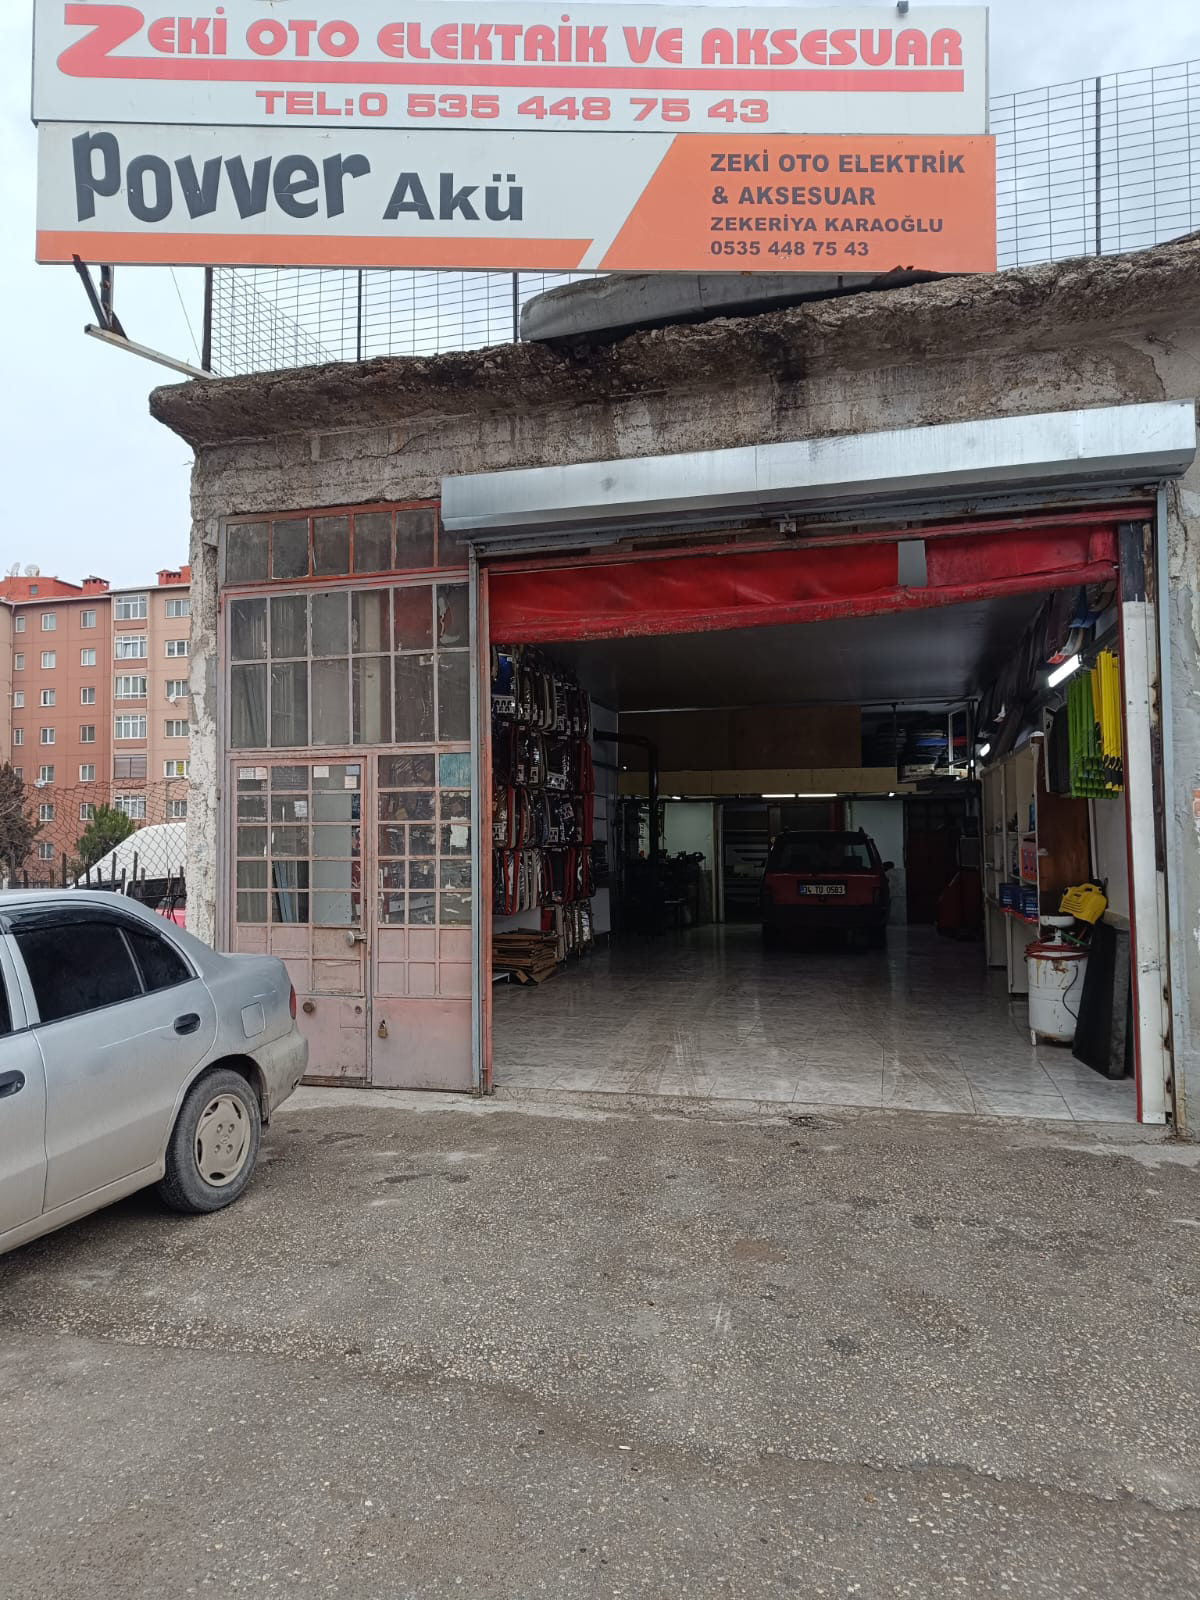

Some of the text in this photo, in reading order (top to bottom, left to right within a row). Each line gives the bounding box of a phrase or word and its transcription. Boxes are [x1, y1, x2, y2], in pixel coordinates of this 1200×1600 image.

[57, 3, 963, 78] ZEKİ OTO ELEKTRİK VE AKSESUAR
[406, 95, 500, 119] 535
[517, 97, 611, 121] 448
[629, 98, 690, 123] 75
[707, 99, 770, 123] 43
[710, 150, 966, 174] ZEKİ OTO ELEKTRİK
[382, 173, 524, 221] Akü
[711, 186, 876, 206] & AKSESUAR
[710, 215, 943, 233] ZEKERİYA KARAOĞLU
[710, 240, 869, 256] 0535 448 75 43
